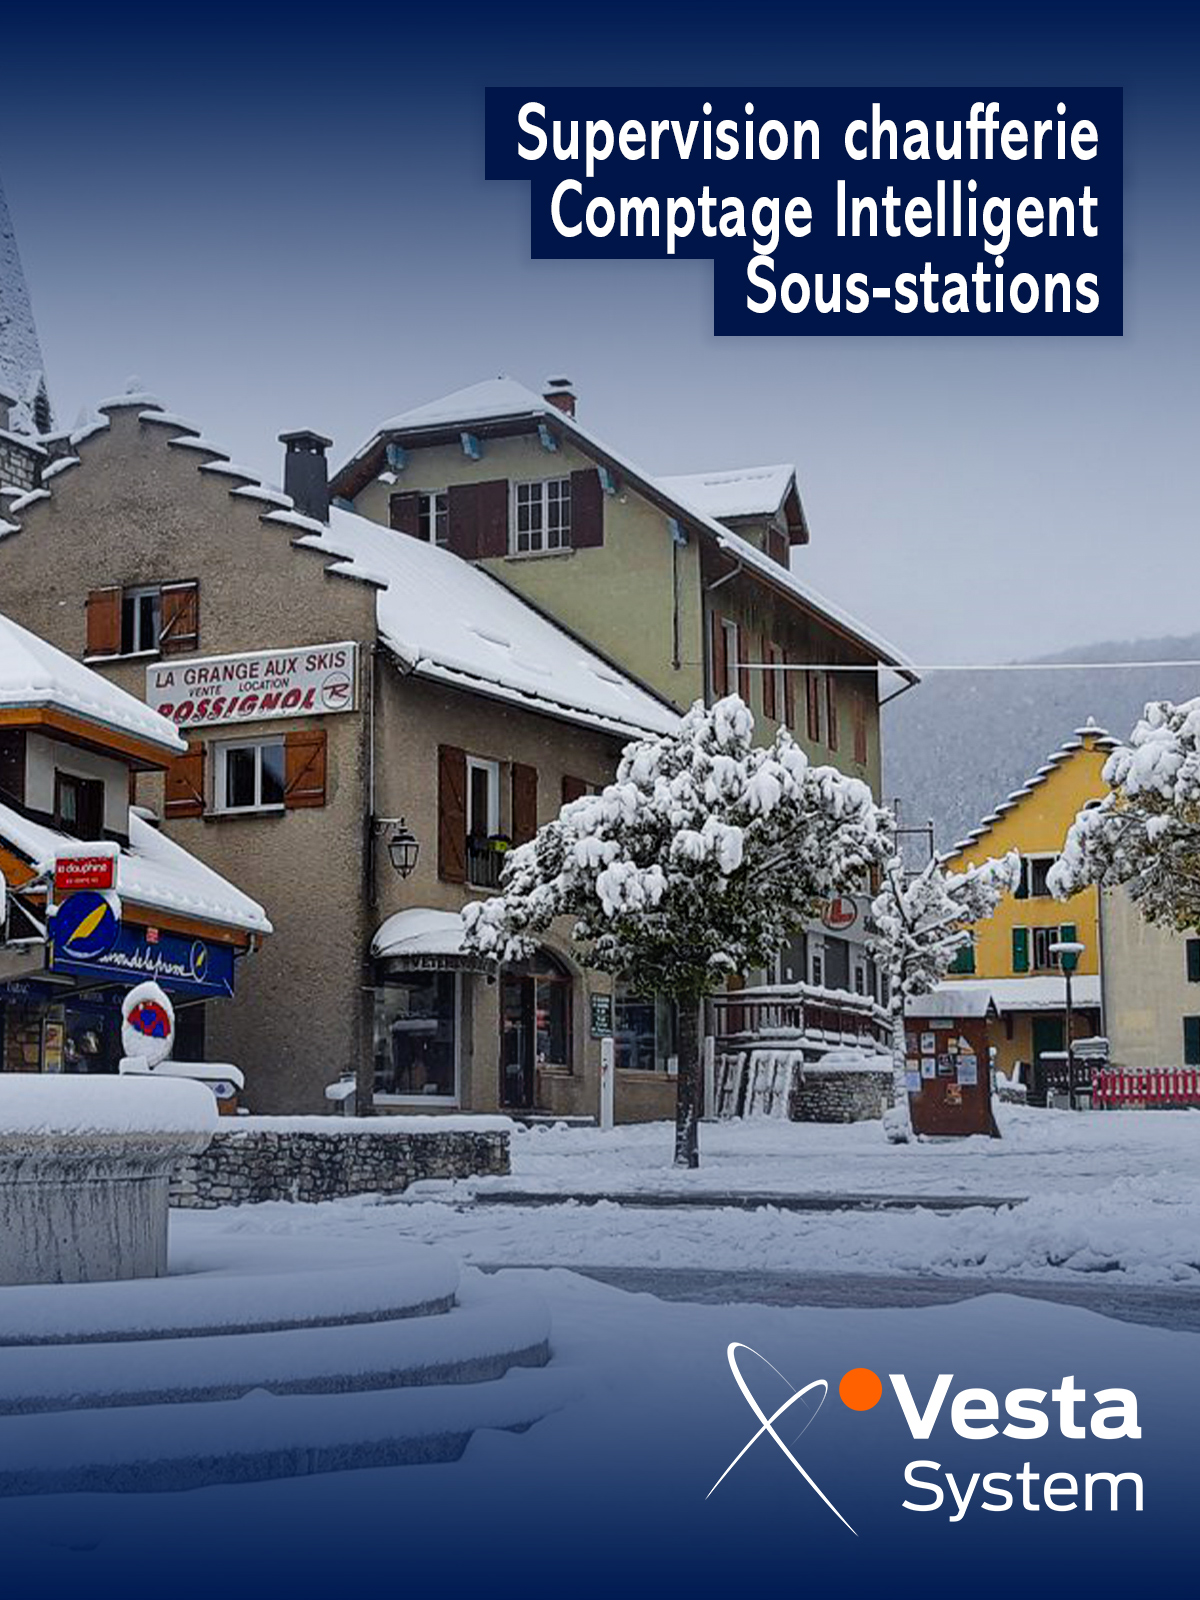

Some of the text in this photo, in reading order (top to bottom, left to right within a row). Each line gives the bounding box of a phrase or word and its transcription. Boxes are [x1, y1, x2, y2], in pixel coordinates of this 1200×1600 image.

[155, 650, 346, 688] LA GRANGE AUX SKIS
[188, 677, 290, 698] VENTE LOCATION
